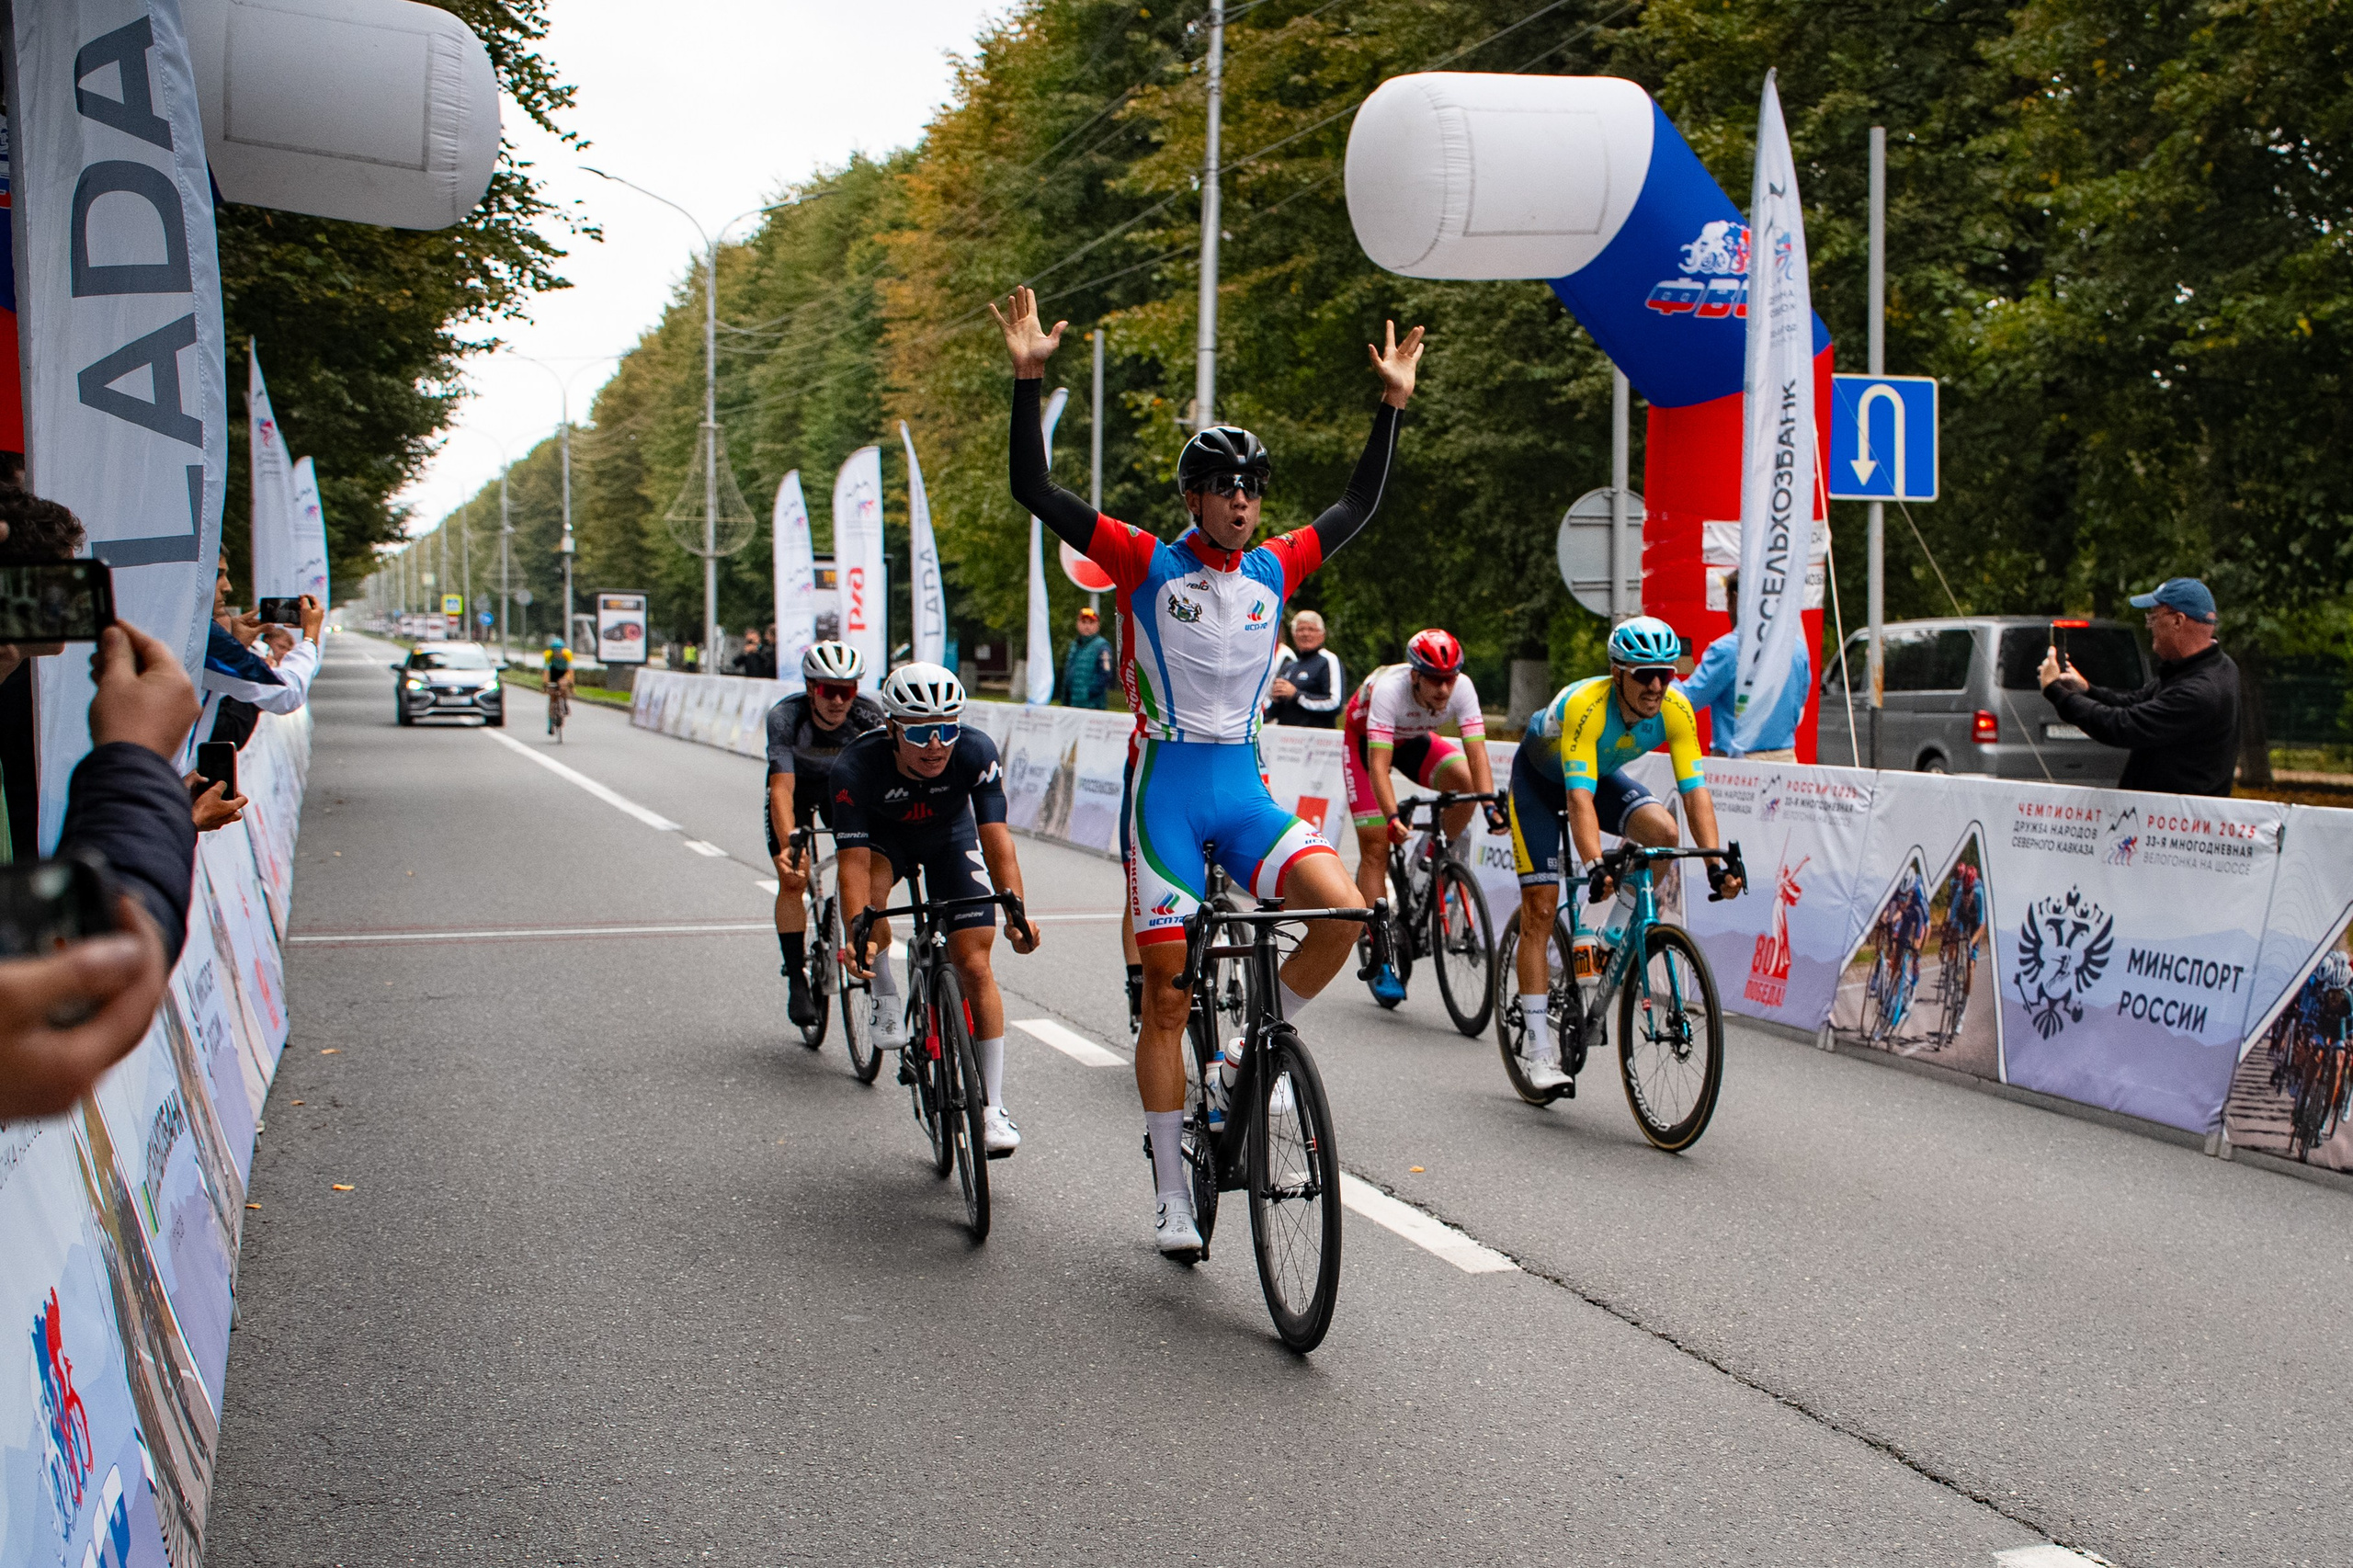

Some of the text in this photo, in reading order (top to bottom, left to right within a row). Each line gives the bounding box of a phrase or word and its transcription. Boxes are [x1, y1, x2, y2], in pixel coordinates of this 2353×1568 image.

[72, 15, 203, 568] LADA
[1645, 278, 1750, 319] ФВ
[920, 549, 941, 636] LADA
[2018, 802, 2102, 824] ЧЕМПИОНАТ
[836, 831, 870, 840] Santin
[2013, 820, 2097, 839] ДРУЖБА НАРОДОВ
[2147, 814, 2256, 839] РОССИИ 2025
[2012, 835, 2095, 855] СЕВЕРНОГО КАВКАЗА
[2145, 835, 2253, 858] 33-Я МНОГОДНЕВНАЯ
[2143, 851, 2197, 869] ВЕЛОГОНКА
[2127, 947, 2245, 994] МИНСПОРТ
[2117, 990, 2208, 1034] РОССИИ
